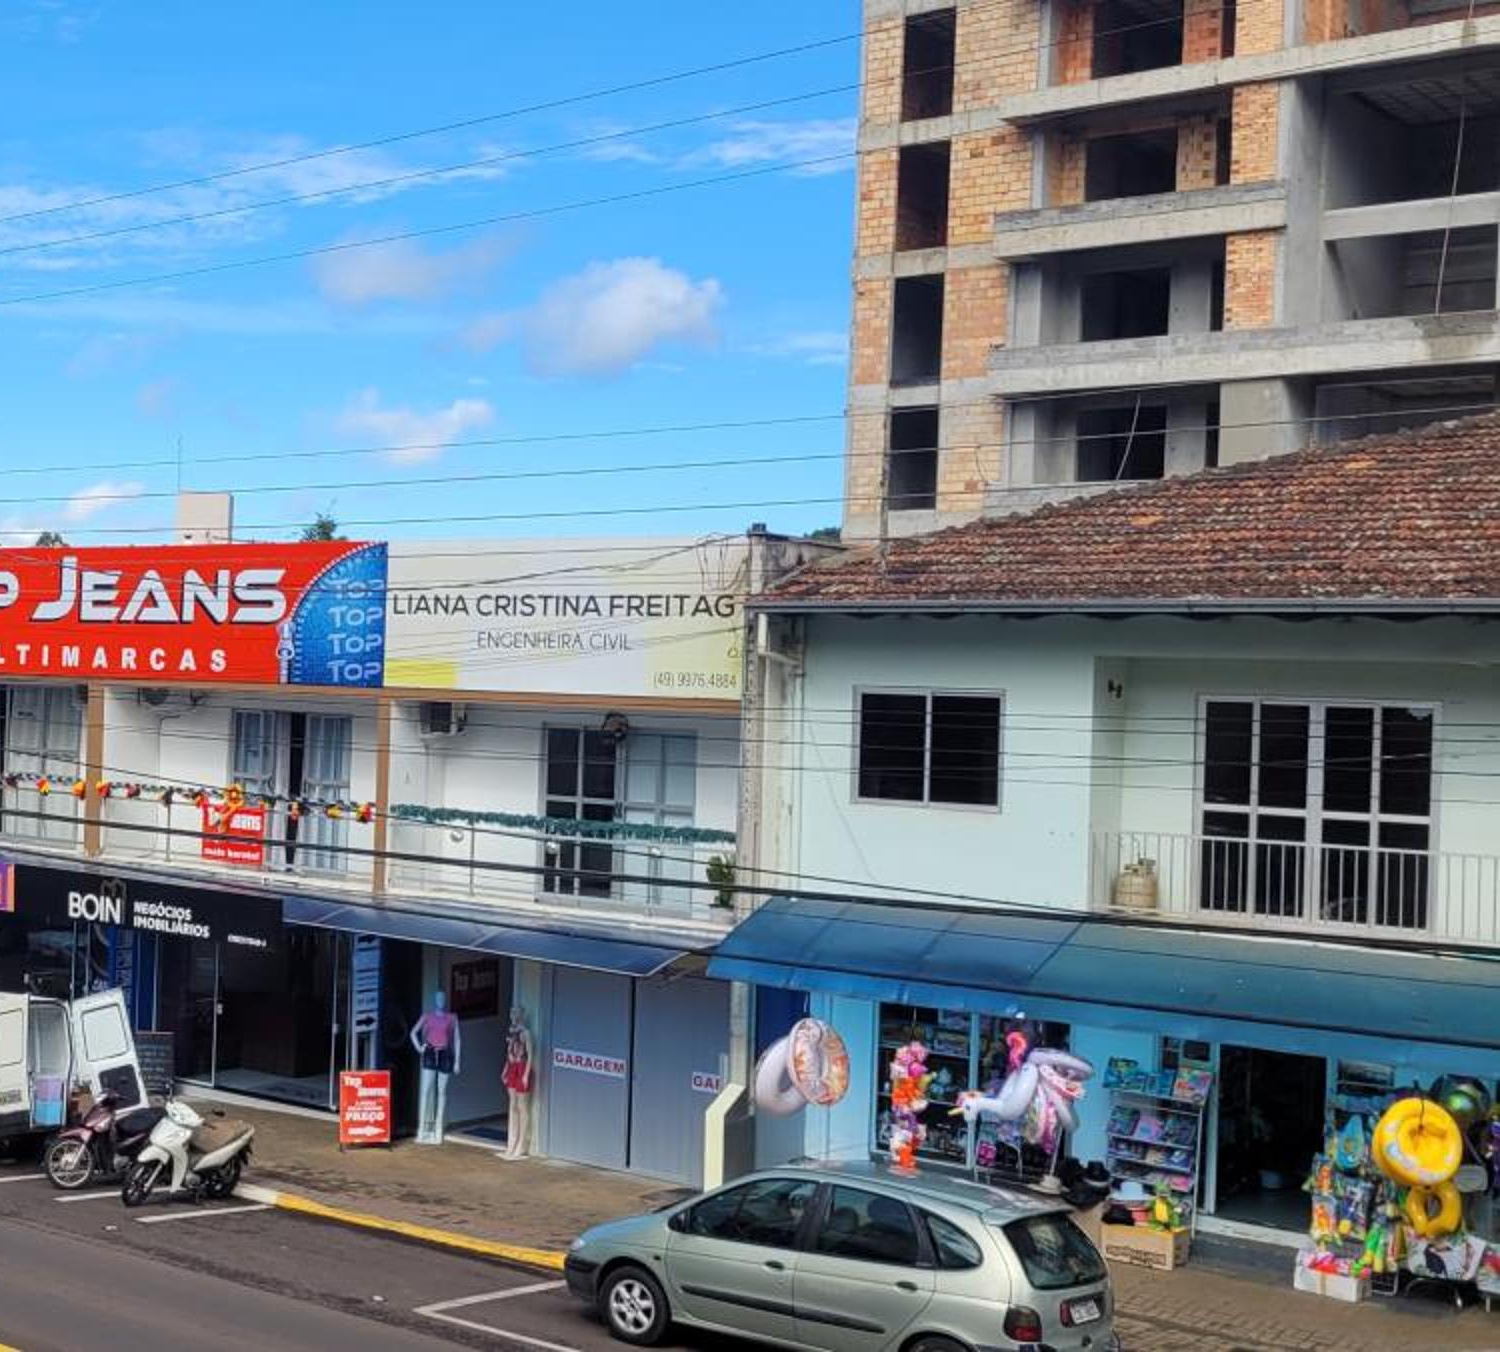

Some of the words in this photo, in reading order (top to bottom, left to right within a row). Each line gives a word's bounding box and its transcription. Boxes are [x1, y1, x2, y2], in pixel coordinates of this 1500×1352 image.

[393, 594, 468, 616] LIANA
[476, 593, 601, 617] CRISTINA
[609, 594, 735, 617] FREITAG
[328, 606, 383, 628] TOP
[327, 633, 382, 655] TOP
[477, 631, 582, 650] ENGENHEIRA
[589, 634, 630, 651] CIVIL
[326, 660, 381, 682] TOP
[654, 671, 675, 688] (49)
[68, 891, 121, 925] BOIN
[133, 901, 192, 921] NEGÓCIOS
[133, 916, 210, 938] IMOBILIÁRIOS
[554, 1051, 626, 1074] GARAGEM
